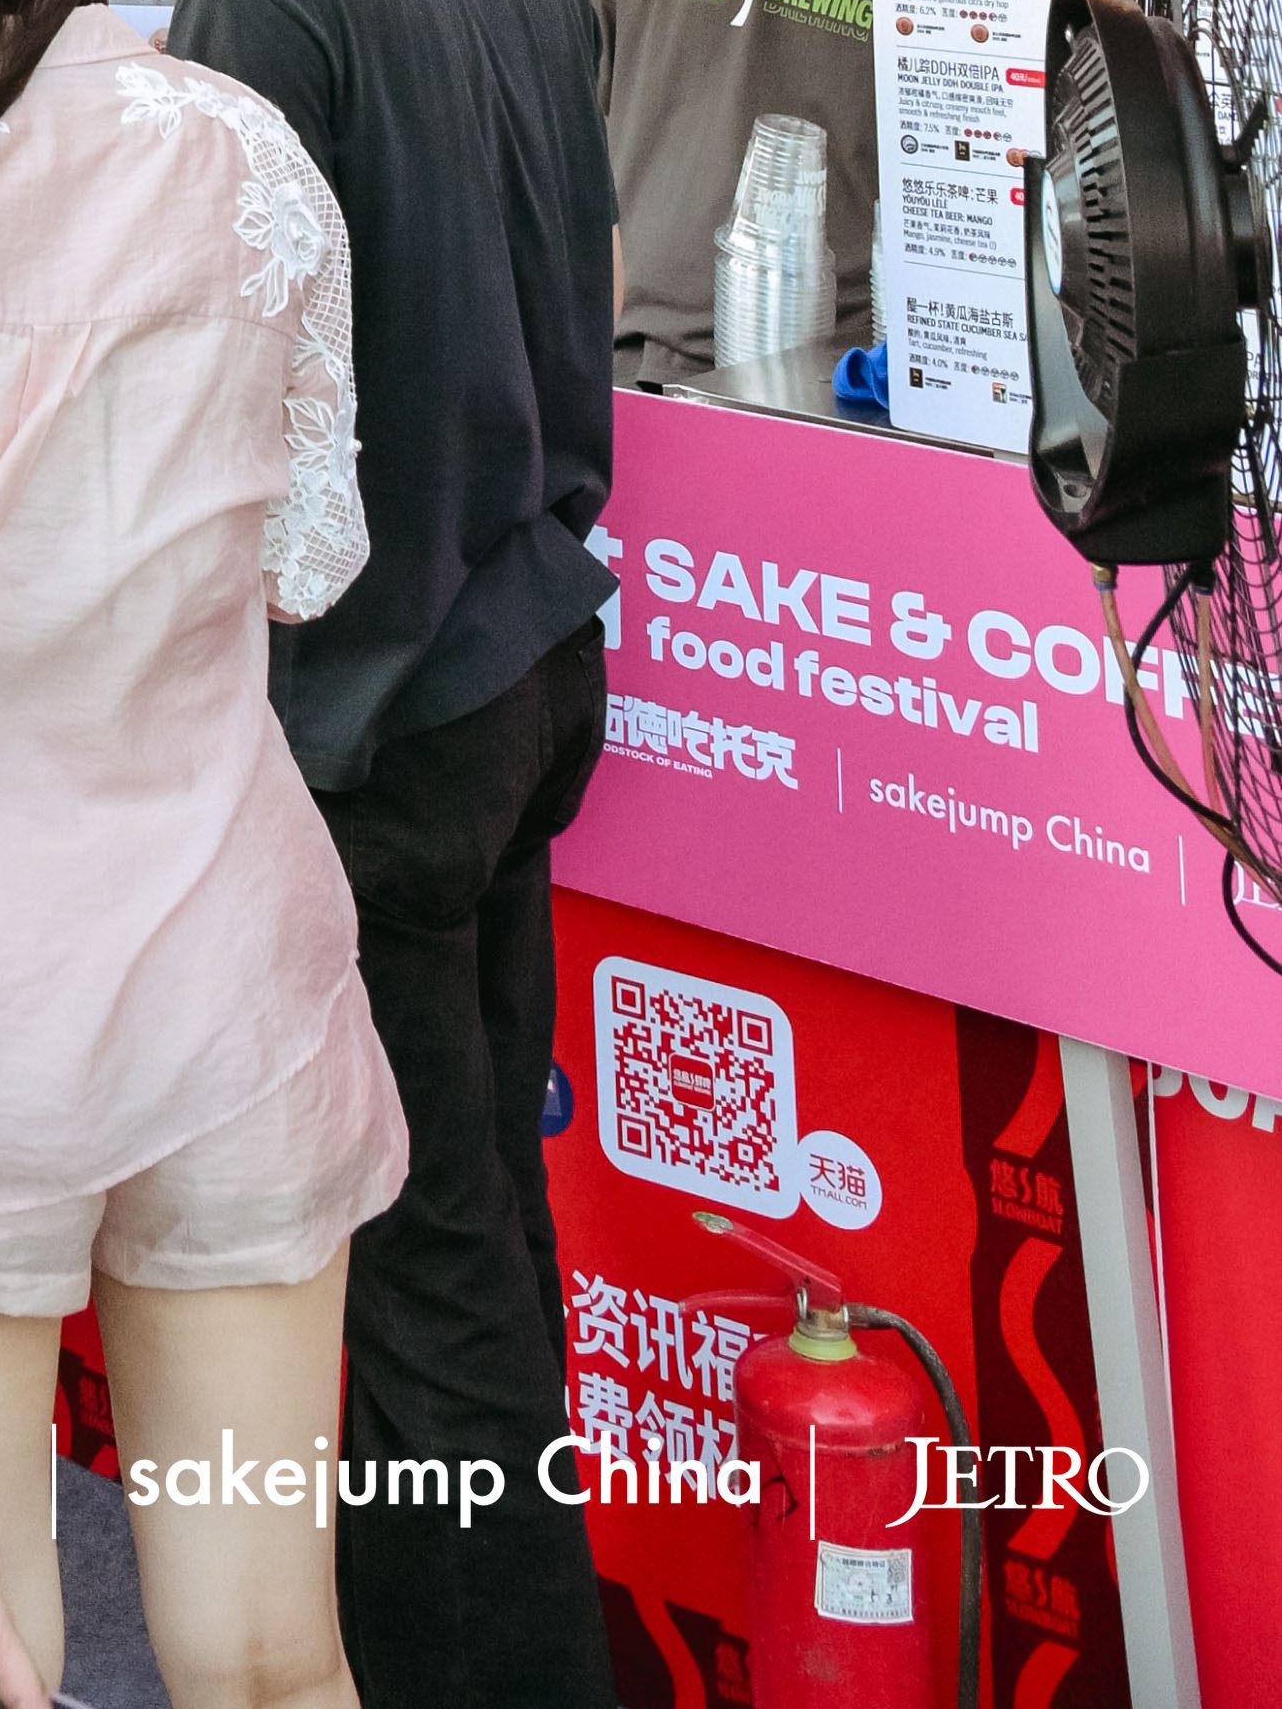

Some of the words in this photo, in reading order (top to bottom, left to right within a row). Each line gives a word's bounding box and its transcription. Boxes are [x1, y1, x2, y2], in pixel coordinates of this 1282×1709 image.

[919, 6, 937, 16] 6.2%
[897, 73, 919, 84] MOON
[920, 75, 941, 87] JELLY
[943, 78, 959, 89] DDH
[960, 80, 990, 92] DOUBLE
[991, 83, 1004, 94] IPA
[923, 122, 940, 134] 7.5%
[902, 205, 928, 217] CHEESE
[930, 208, 944, 219] TEA
[945, 210, 966, 223] BEER:
[967, 213, 993, 226] MANGO
[907, 314, 936, 328] REFINED
[937, 319, 961, 332] STATE
[961, 323, 1002, 339] CUCUMBER
[1003, 330, 1017, 341] SEA
[932, 356, 949, 369] 4.0%
[643, 537, 874, 647] SAKE
[889, 590, 952, 661] &
[646, 616, 785, 691] food
[793, 650, 1040, 754] festival
[656, 754, 671, 768] OF
[673, 759, 713, 779] EATING
[869, 773, 1035, 850] sakejump
[1046, 815, 1152, 874] China
[809, 1153, 866, 1198] 天猫
